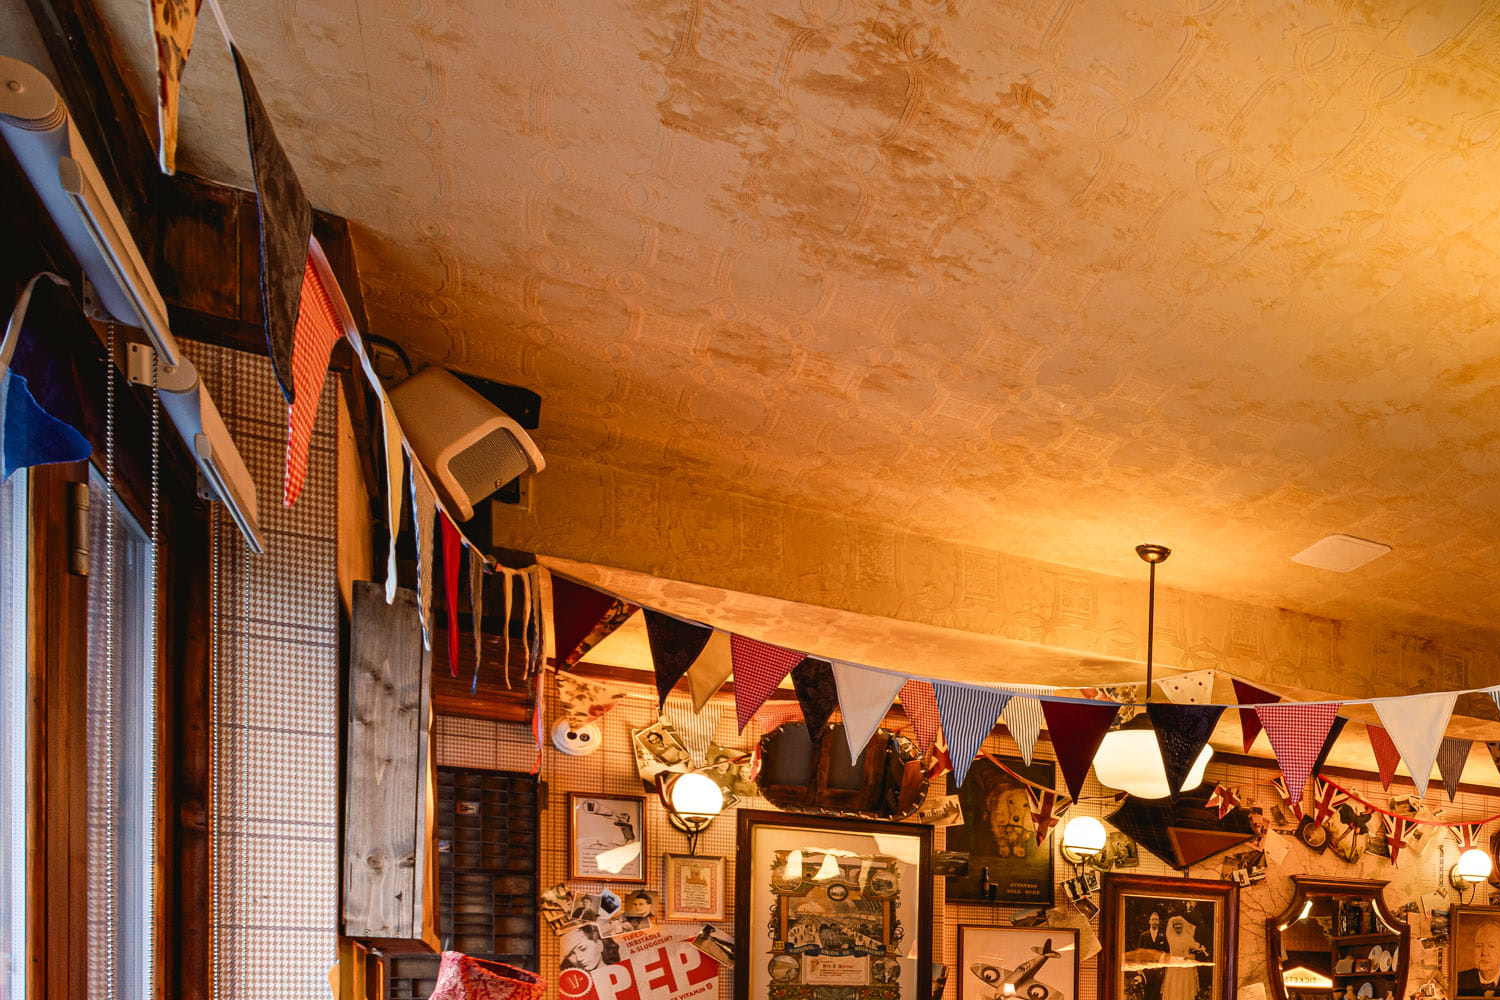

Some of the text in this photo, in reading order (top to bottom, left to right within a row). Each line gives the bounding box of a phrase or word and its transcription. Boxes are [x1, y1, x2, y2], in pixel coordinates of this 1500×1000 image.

[626, 932, 661, 948] IRRITABLE
[636, 936, 673, 953] SLUGGISH?
[679, 987, 706, 1000] VITAMIN
